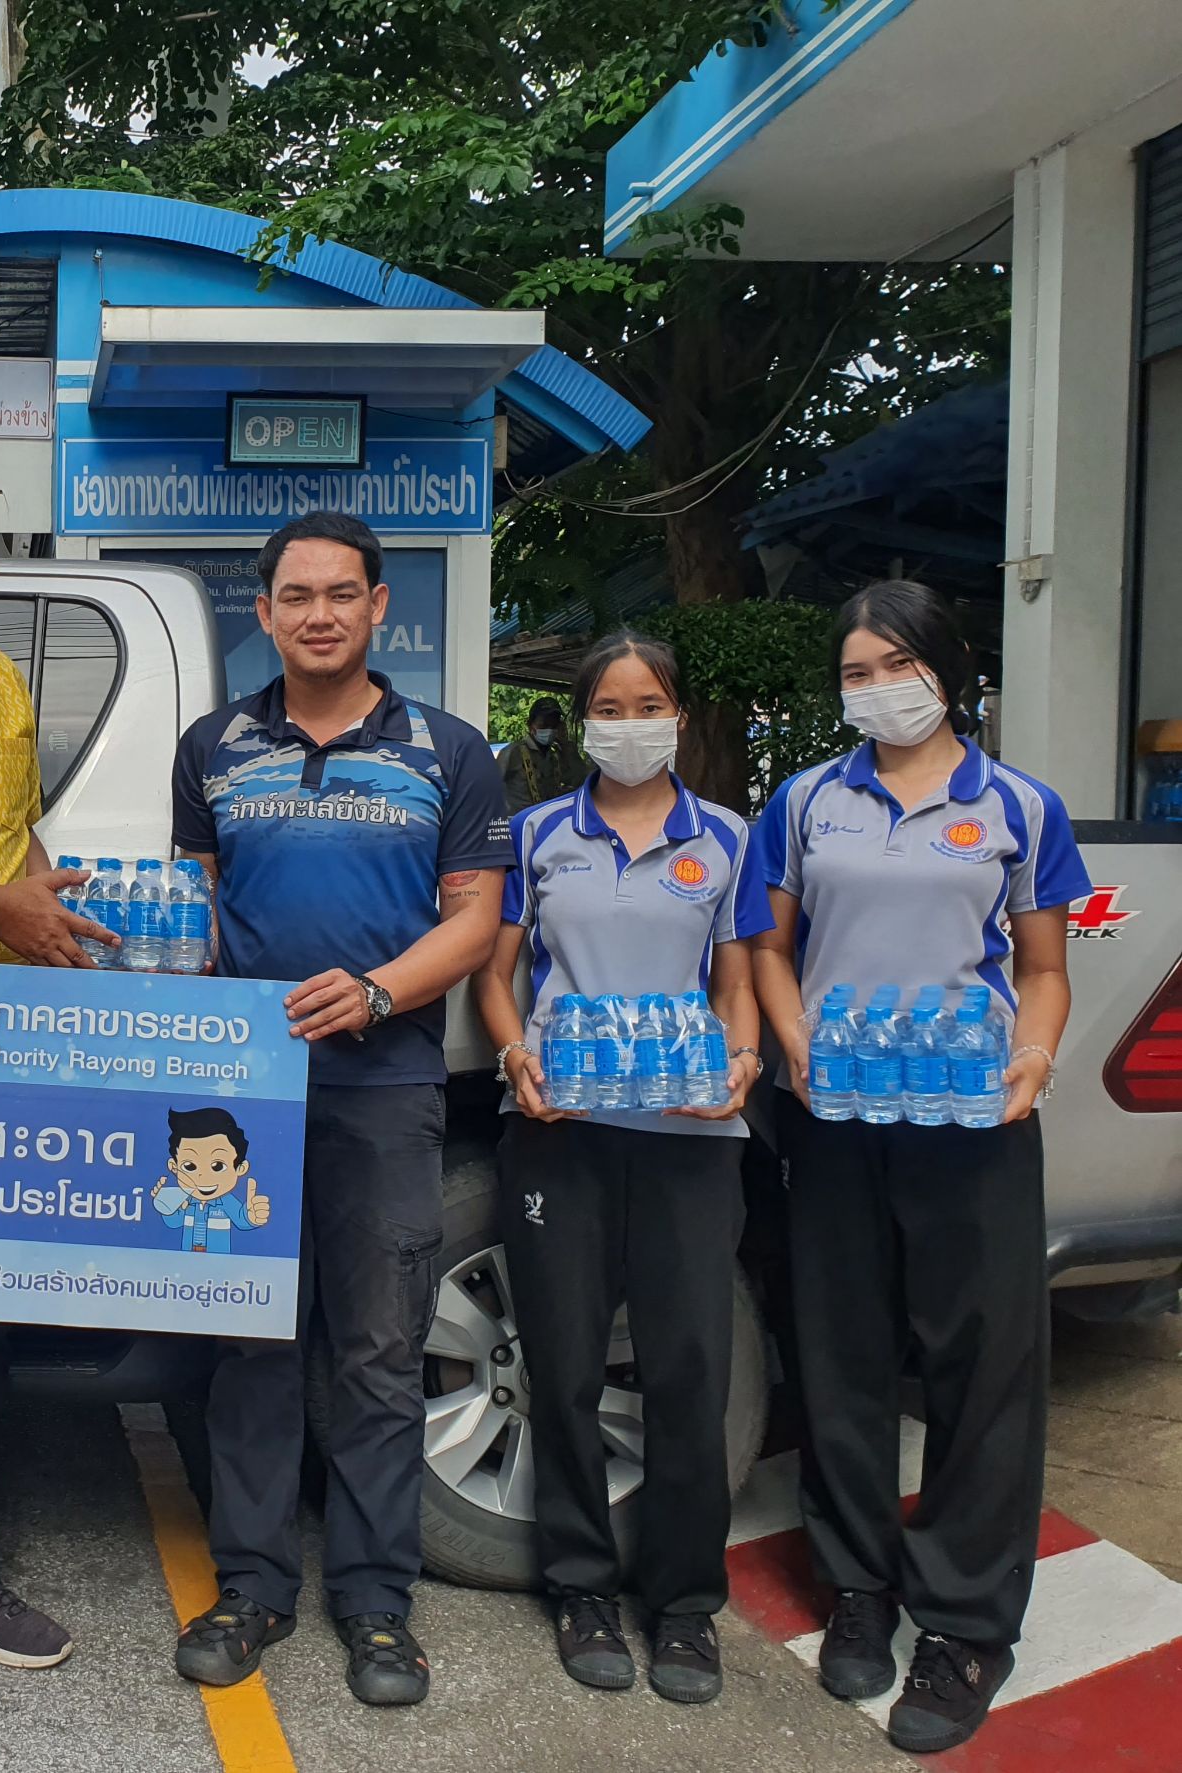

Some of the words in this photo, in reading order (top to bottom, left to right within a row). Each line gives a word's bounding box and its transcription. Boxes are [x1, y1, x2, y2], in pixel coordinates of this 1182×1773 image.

[244, 415, 346, 449] OPEN
[69, 1050, 156, 1079] Rayong
[166, 1056, 249, 1080] Branch
